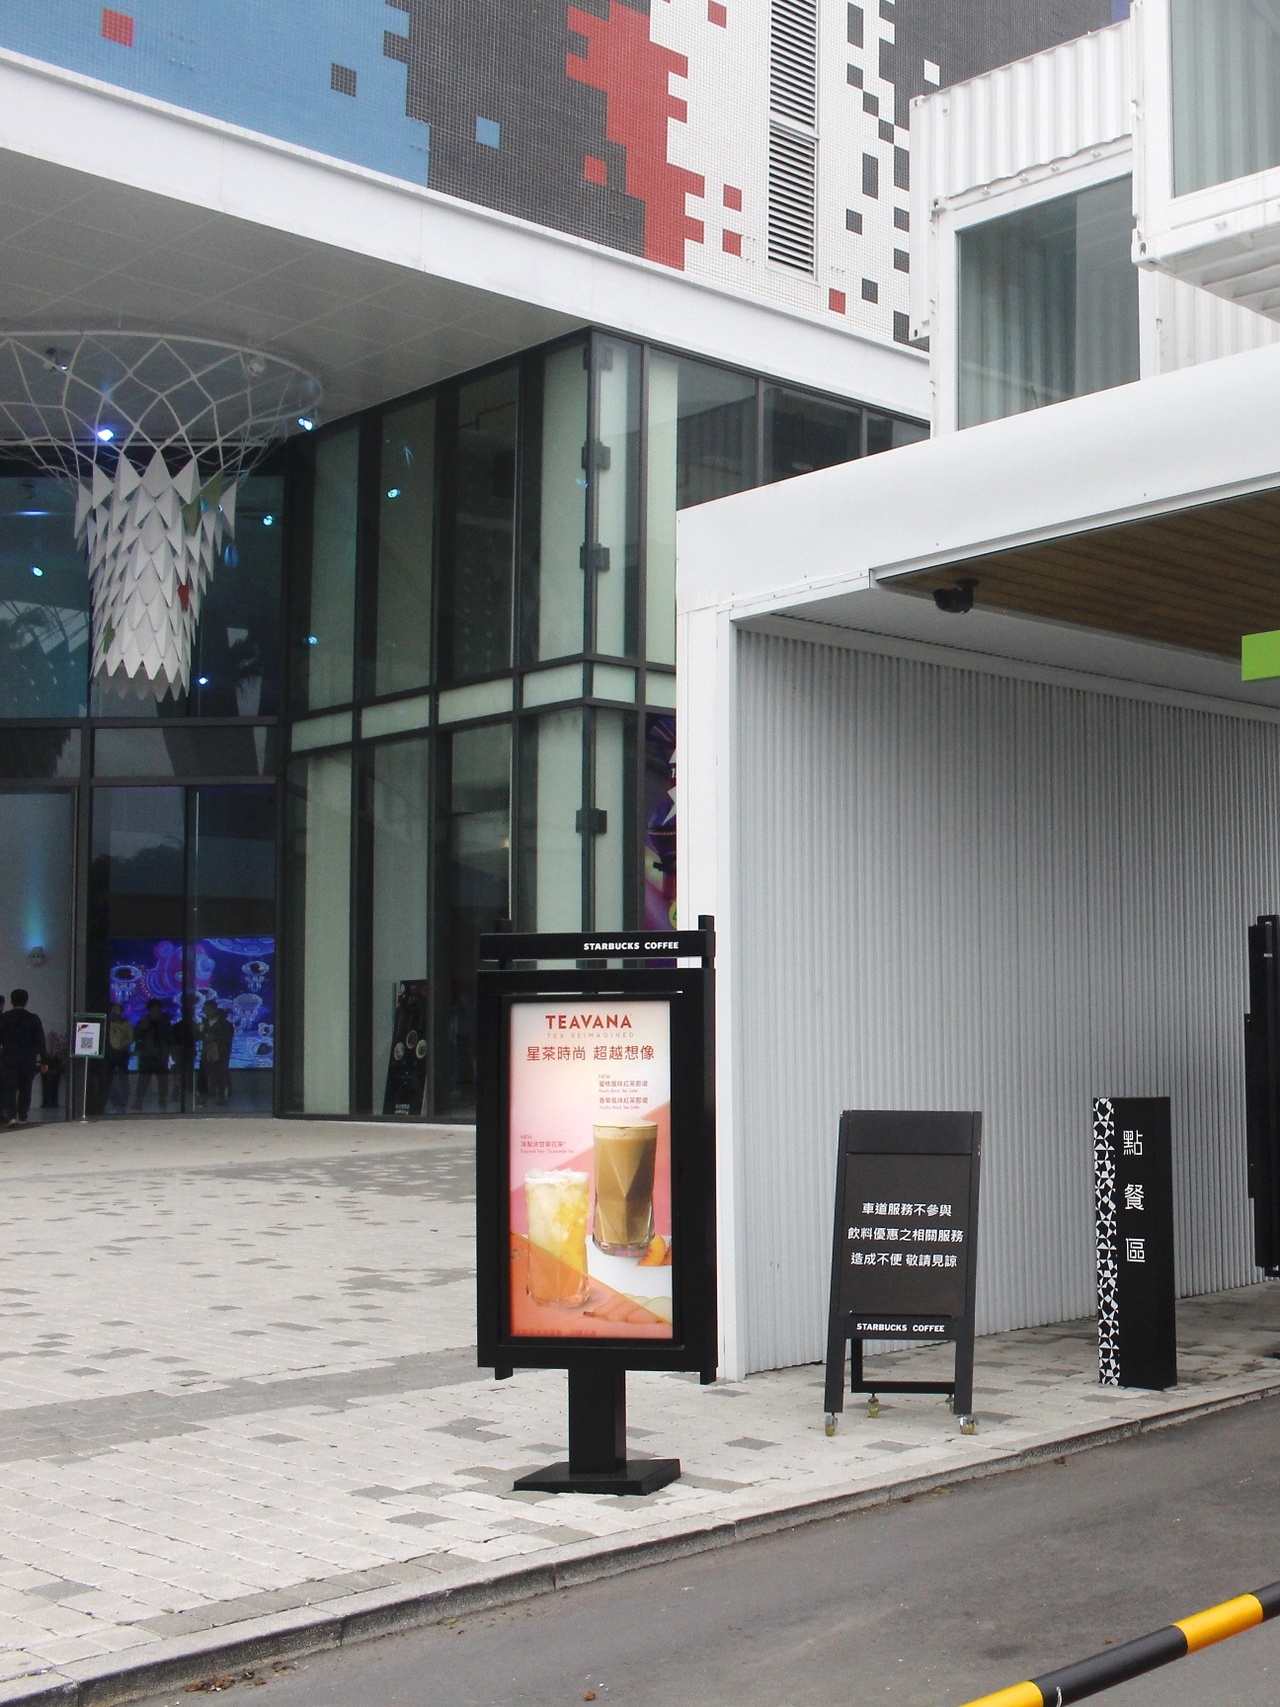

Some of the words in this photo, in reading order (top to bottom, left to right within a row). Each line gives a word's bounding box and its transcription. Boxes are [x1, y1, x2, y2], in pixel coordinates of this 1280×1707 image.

[583, 942, 640, 951] STARBUCKS
[644, 941, 679, 950] COFFEE
[545, 1014, 632, 1029] TEAVANA
[570, 1031, 635, 1039] REIMAGINED
[526, 1046, 586, 1061] 星茶時尚
[593, 1045, 655, 1060] 超越想像
[1123, 1130, 1145, 1263] 點餐區
[862, 1202, 952, 1217] 車道服務不參與
[847, 1227, 964, 1243] 飲料優惠之相關服務
[850, 1252, 902, 1267] 造成不便
[906, 1254, 958, 1268] 敬請見諒
[856, 1323, 907, 1332] STARBUCKS
[912, 1324, 945, 1333] COFFEE
